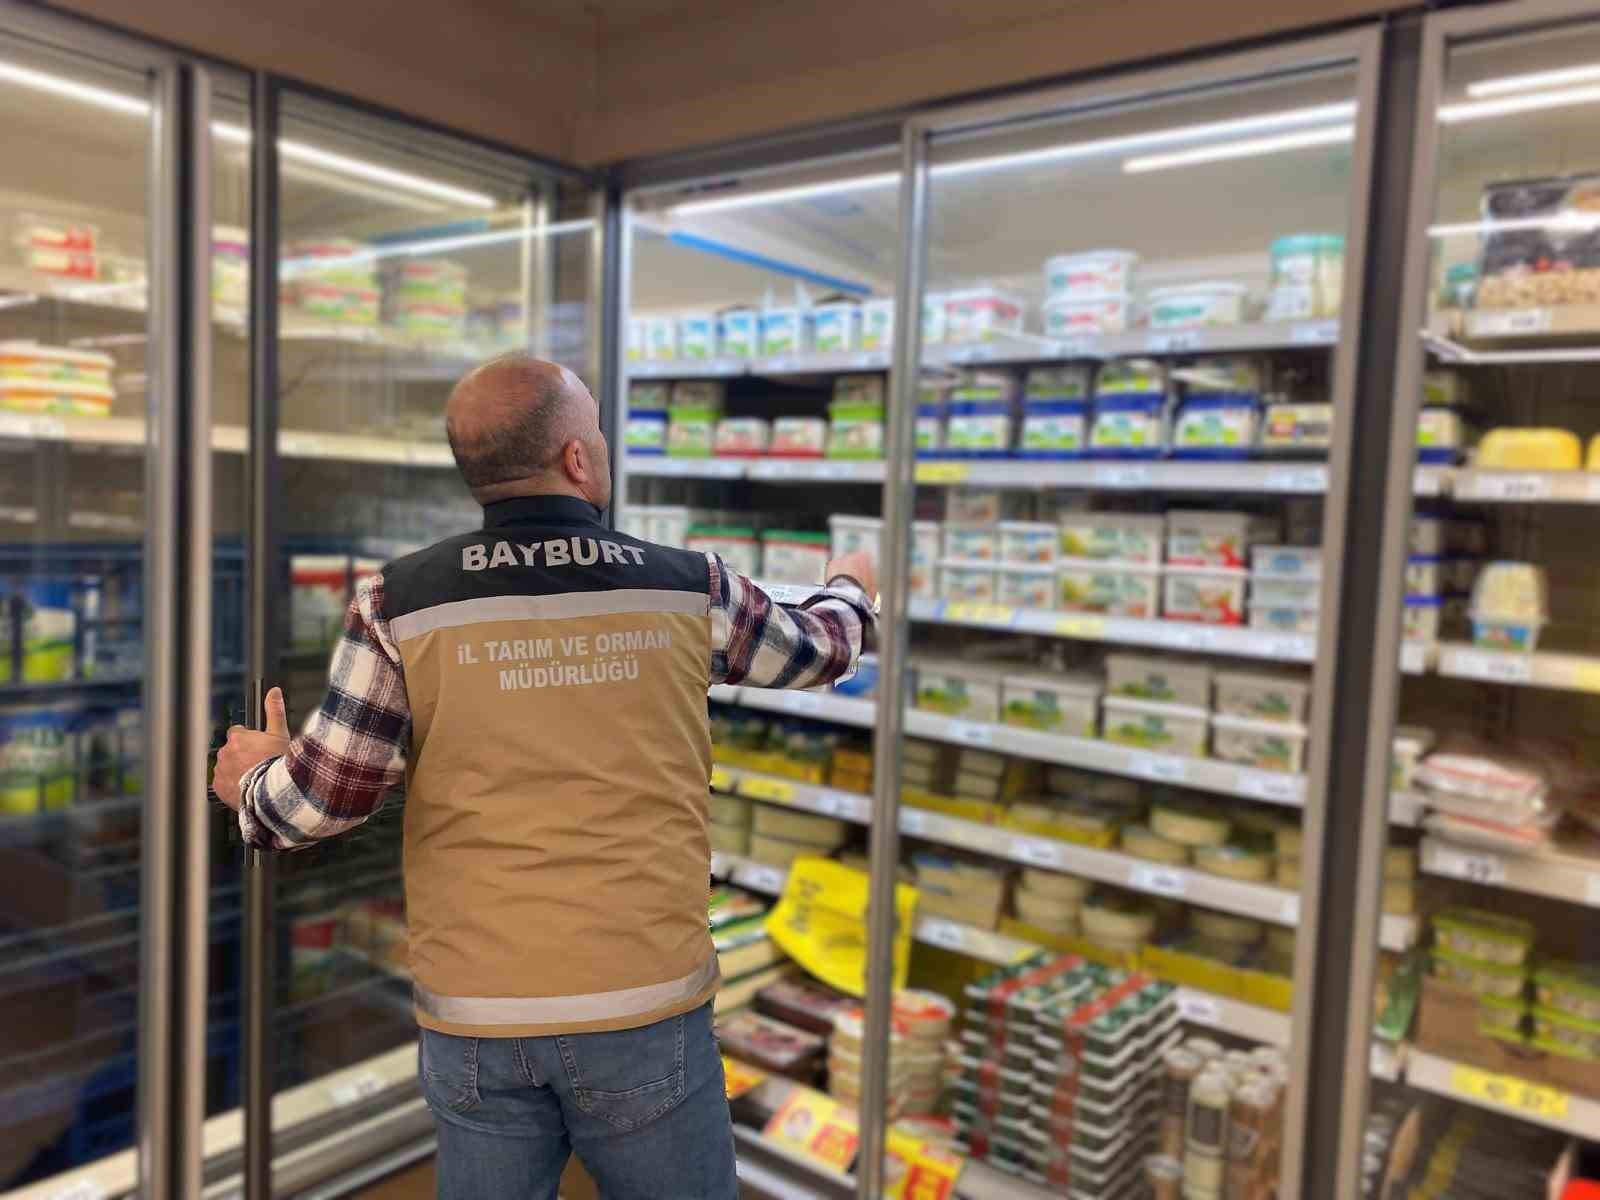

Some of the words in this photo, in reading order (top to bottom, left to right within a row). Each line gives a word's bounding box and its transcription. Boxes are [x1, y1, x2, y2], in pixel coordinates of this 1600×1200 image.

[461, 540, 646, 572] BAYBURT
[485, 637, 553, 662] TARIM
[560, 635, 589, 657] VE
[595, 629, 672, 653] ORMAN
[499, 655, 639, 691] MÜDÜRLÜĞÜ
